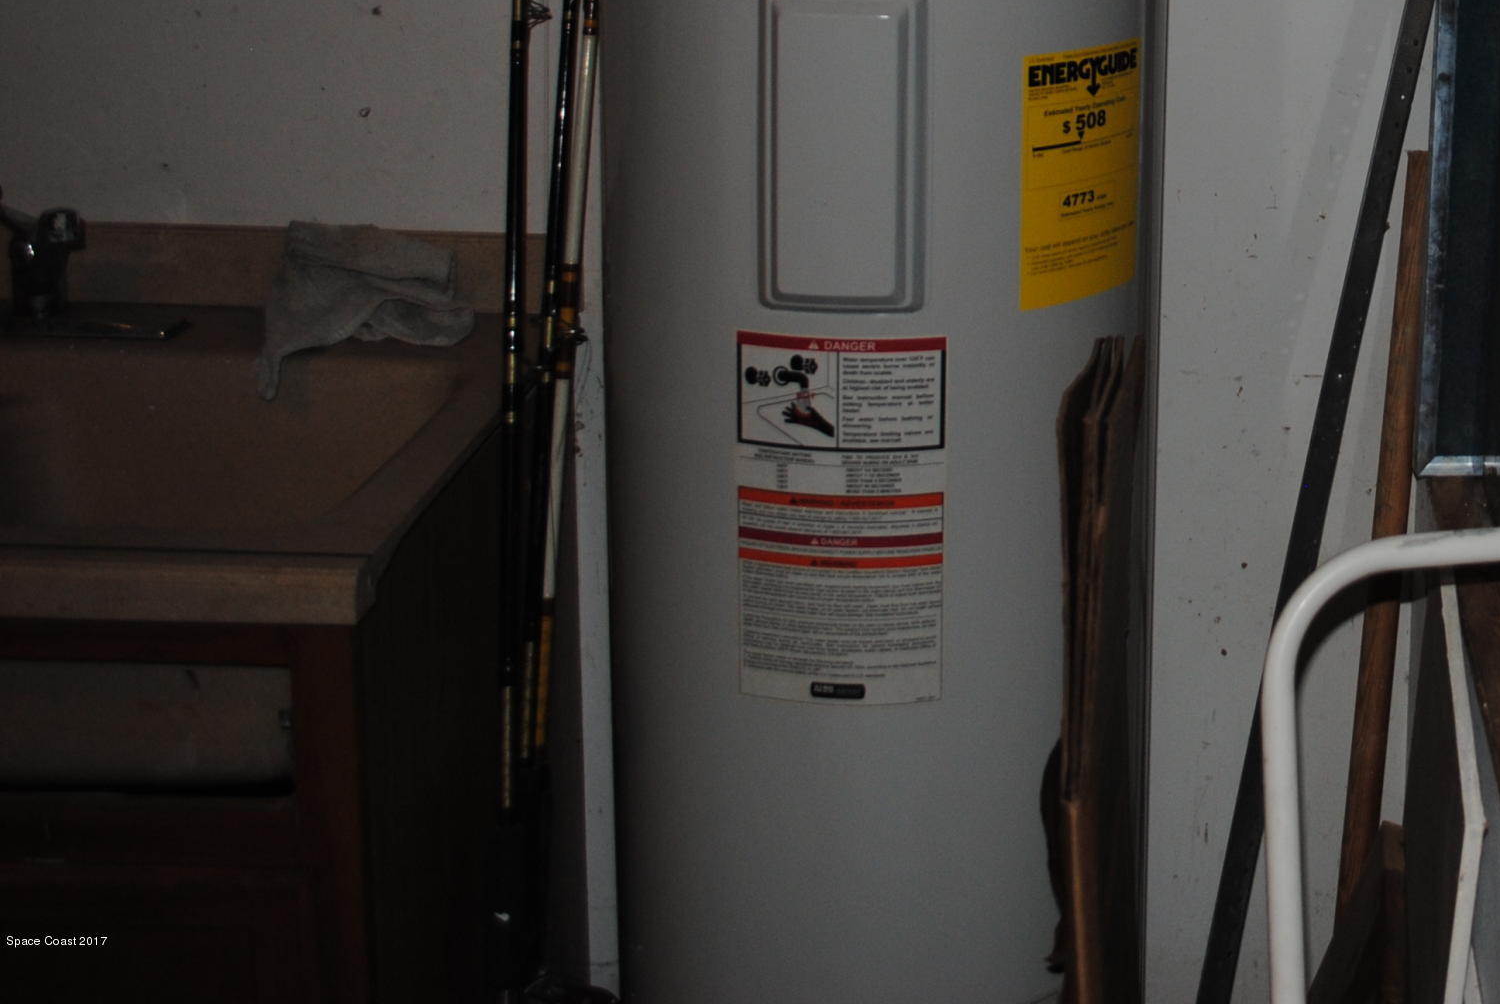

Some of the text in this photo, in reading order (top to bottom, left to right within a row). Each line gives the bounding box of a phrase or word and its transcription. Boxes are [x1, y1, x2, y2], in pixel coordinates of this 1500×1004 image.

[1028, 47, 1137, 87] ENERGYGUIDE
[1062, 109, 1106, 134] $ 508
[1062, 189, 1095, 208] 4773
[823, 340, 877, 351] DANGER
[820, 538, 858, 546] DANGER
